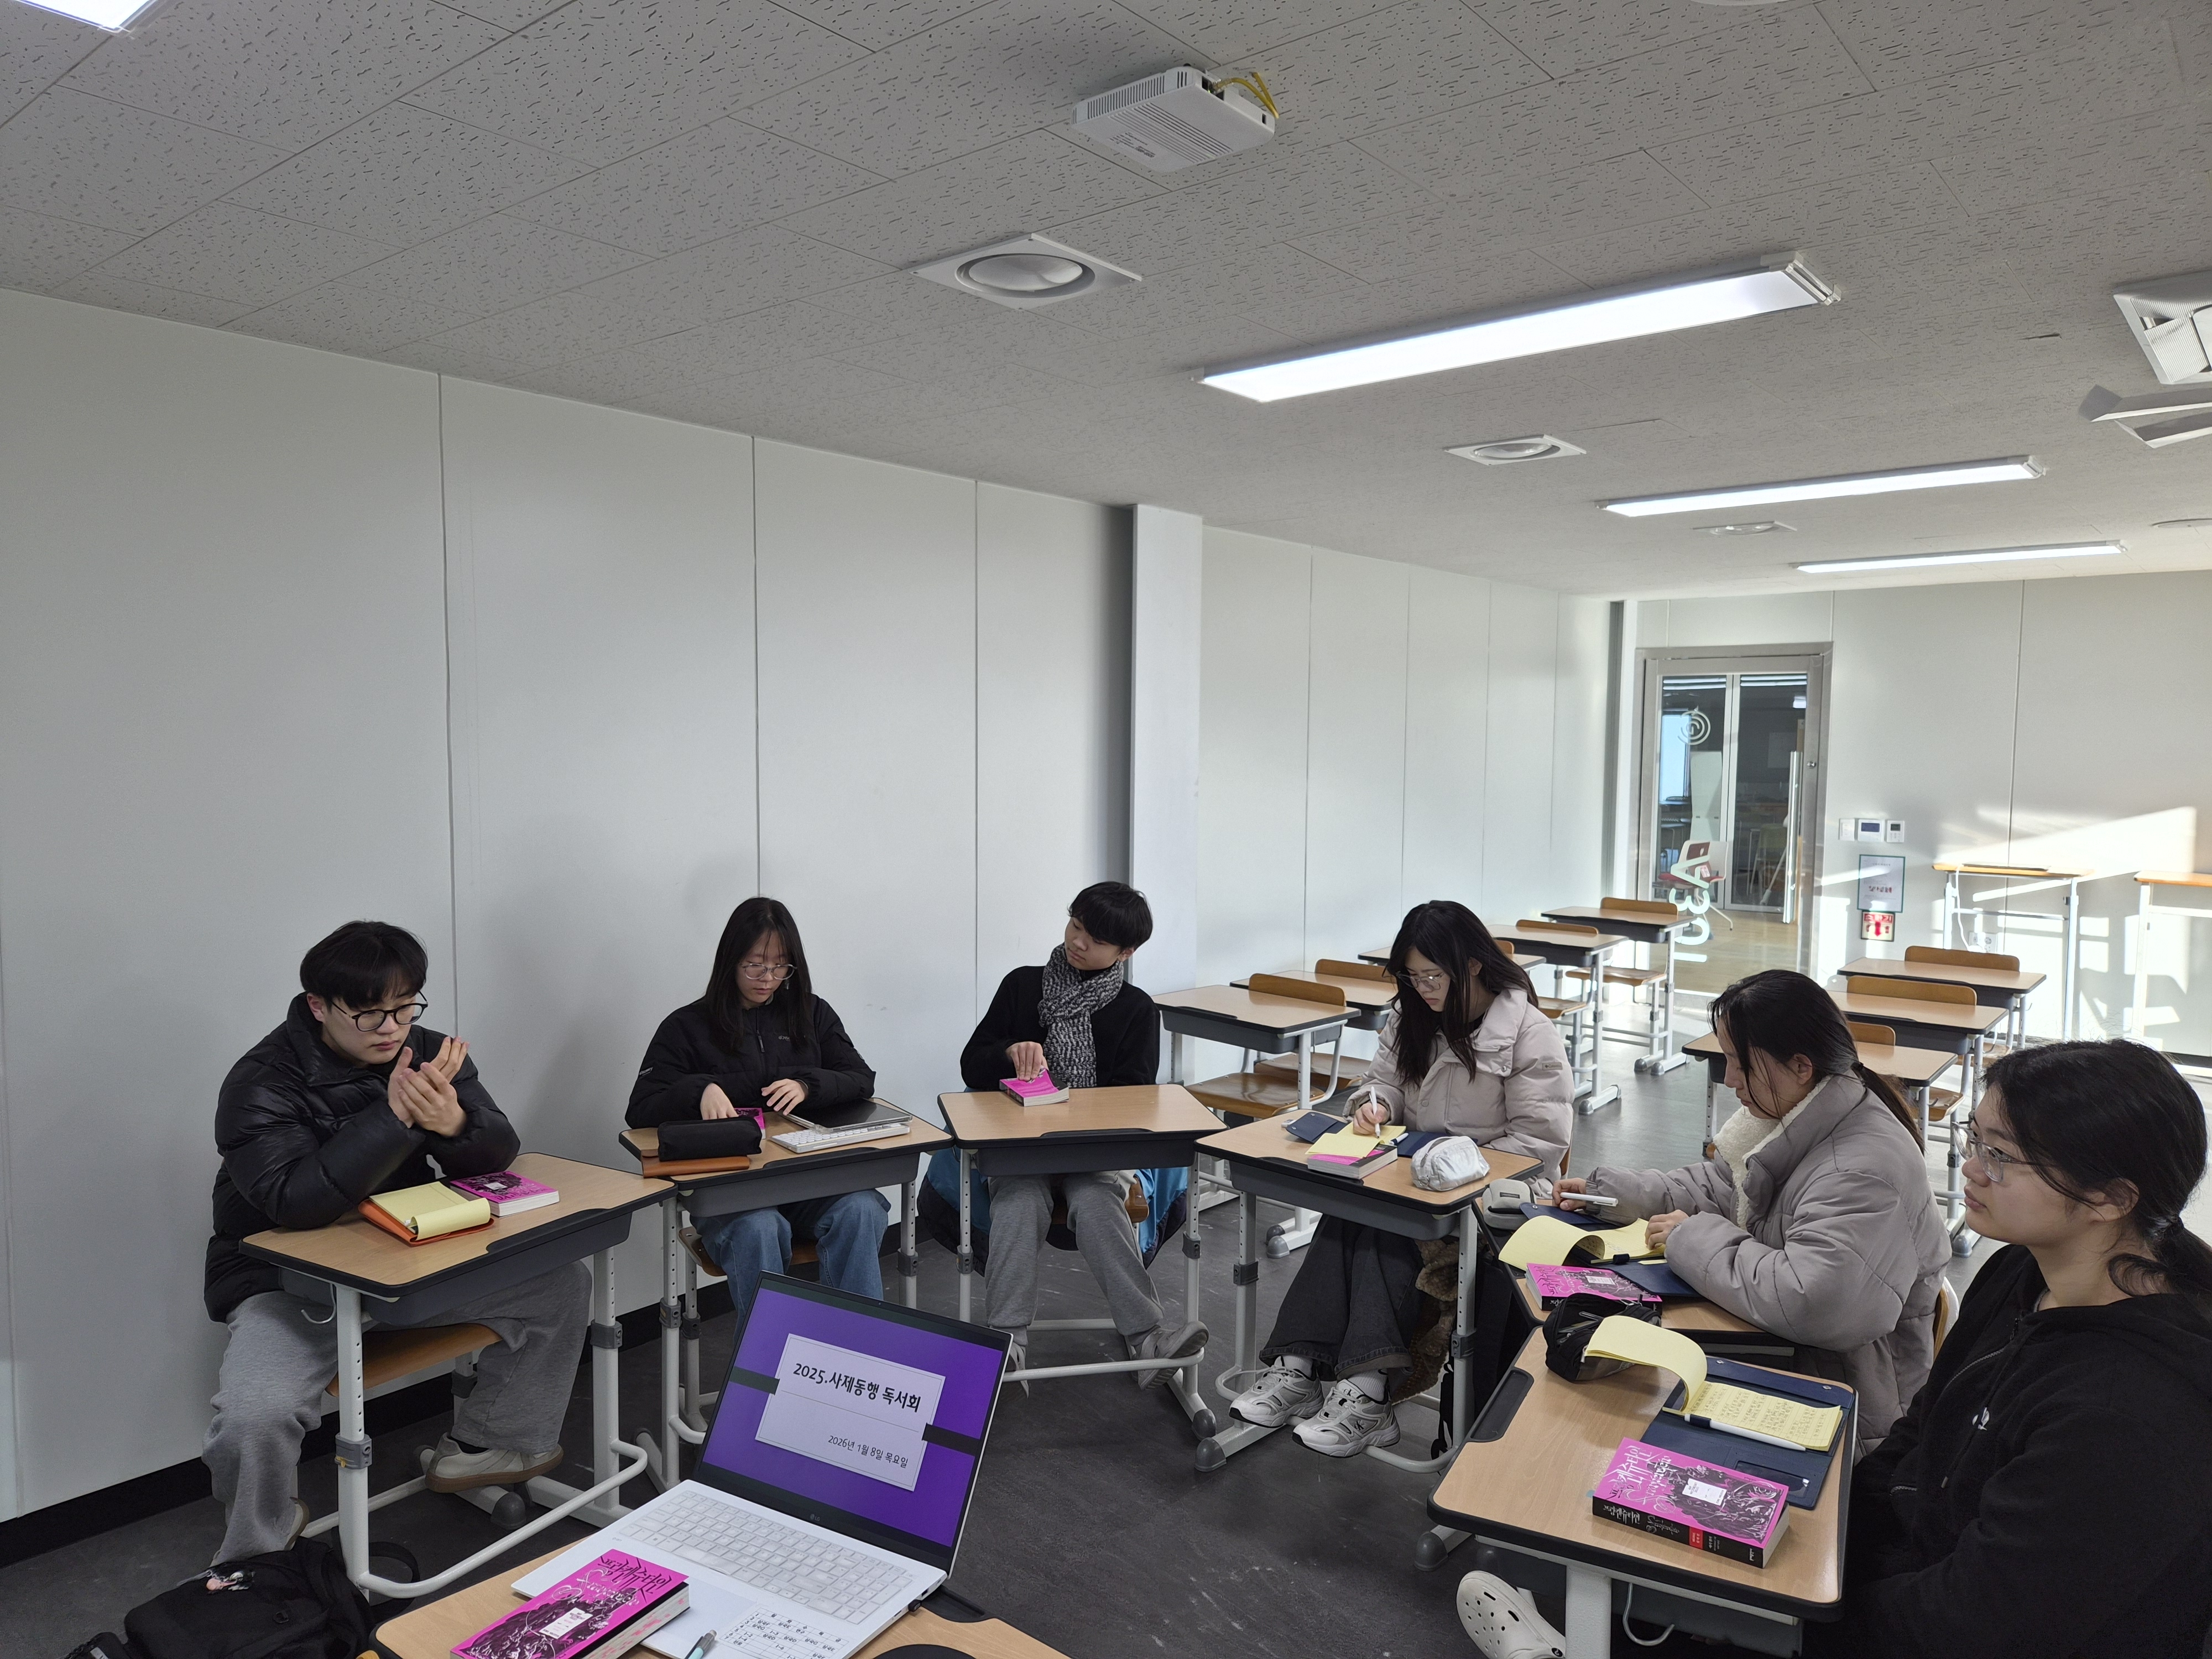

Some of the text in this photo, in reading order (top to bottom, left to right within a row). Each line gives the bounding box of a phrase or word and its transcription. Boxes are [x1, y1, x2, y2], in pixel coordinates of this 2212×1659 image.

[793, 1363, 921, 1412] 2025.사제동행 독서회
[828, 1436, 908, 1468] 2026년 1월 8일 목요일
[1603, 1505, 1640, 1524] 프랑켄슈타인
[598, 1556, 672, 1603] 프랑켄슈타인
